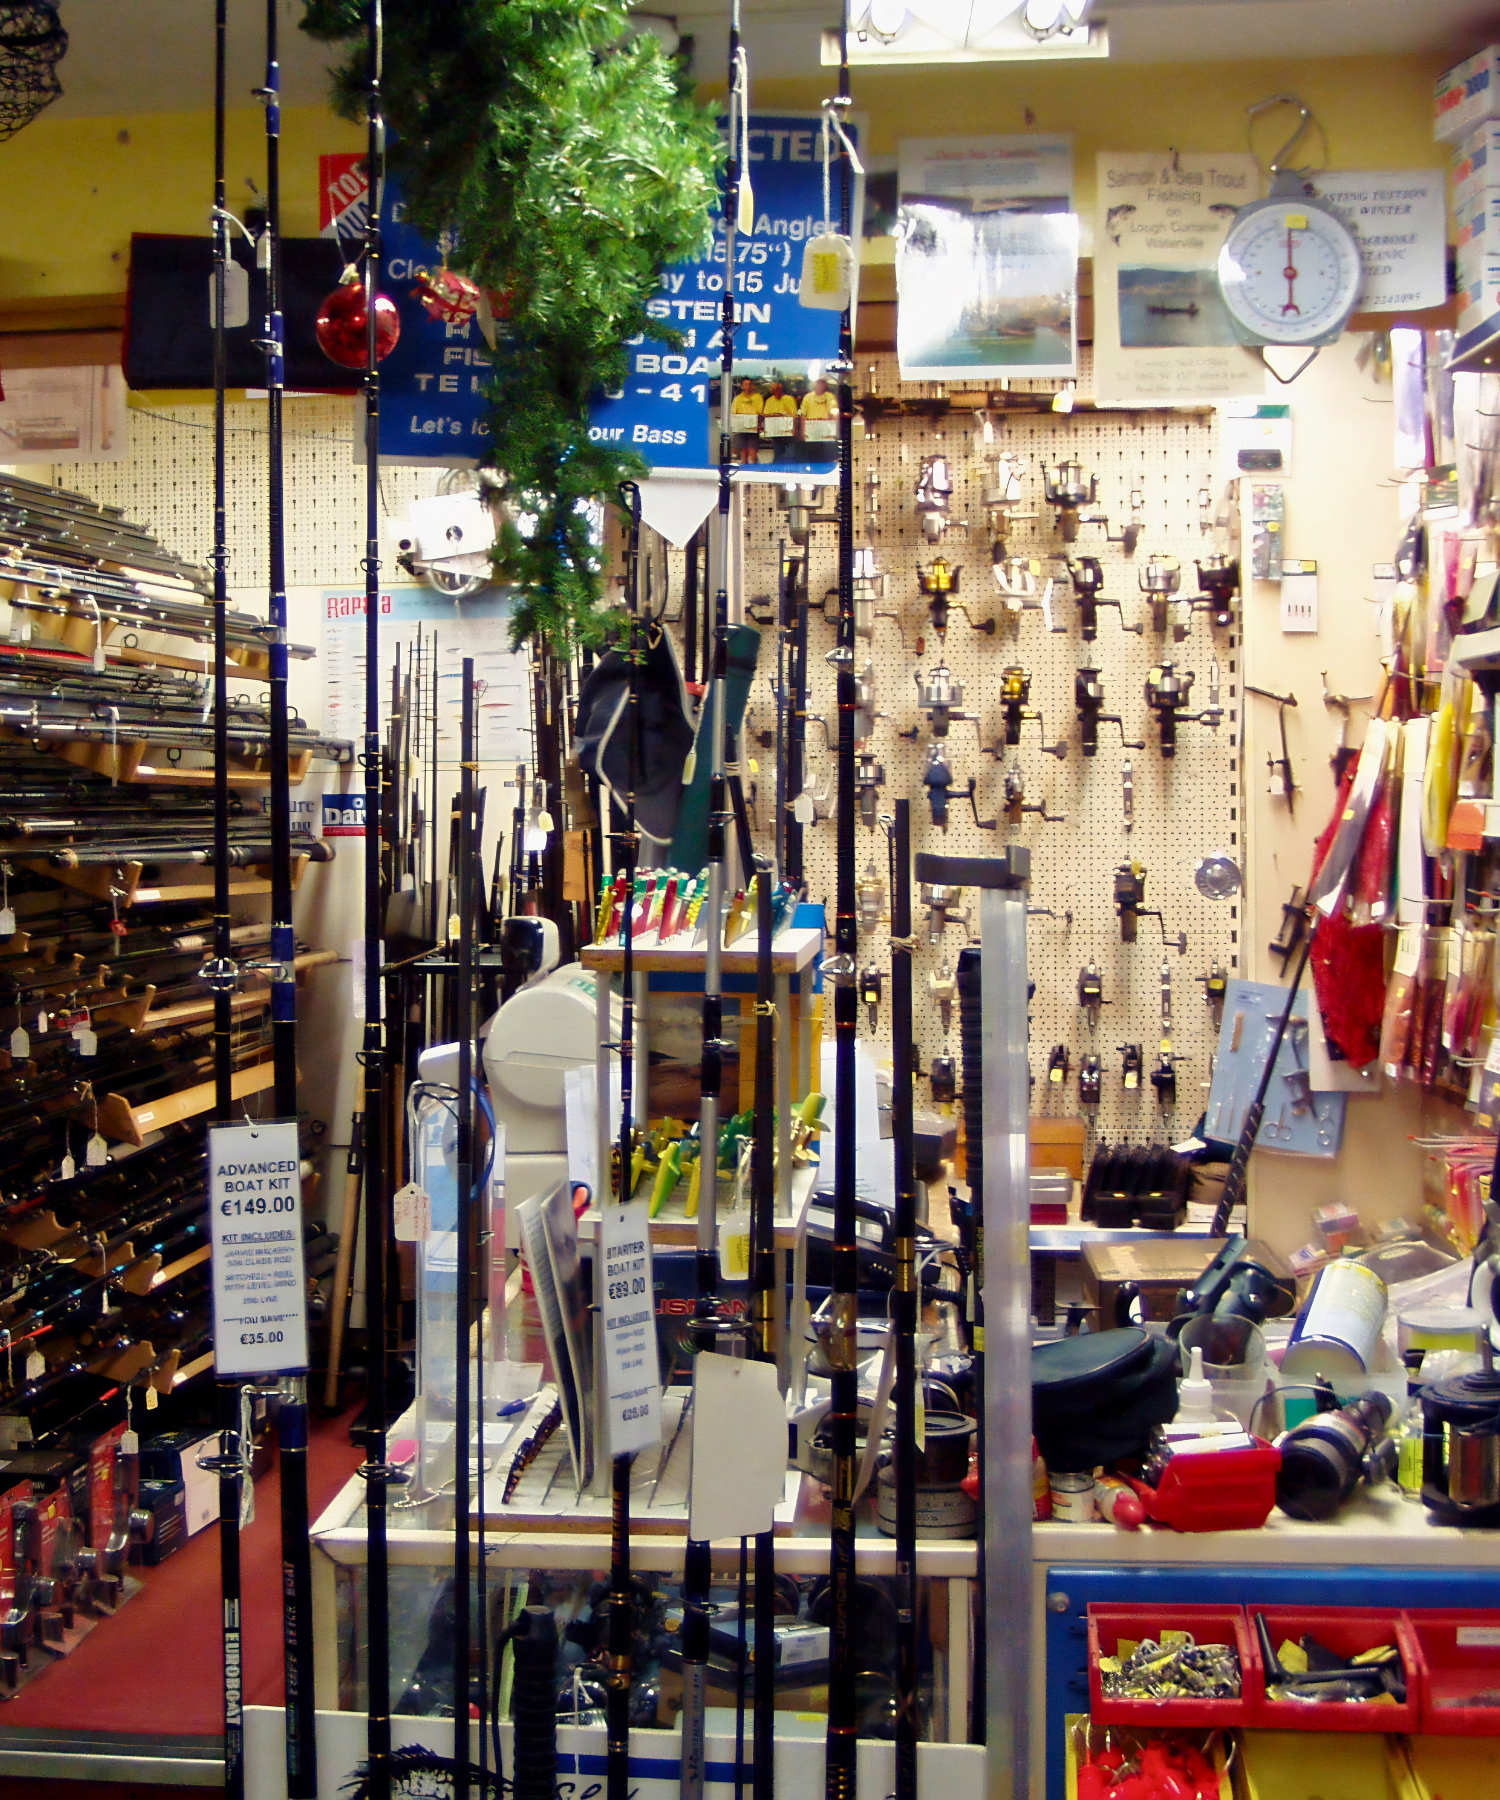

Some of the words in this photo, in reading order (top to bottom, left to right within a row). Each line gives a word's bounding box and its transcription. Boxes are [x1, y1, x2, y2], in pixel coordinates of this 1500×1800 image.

[722, 128, 841, 163] CTED
[388, 258, 428, 280] Clo
[696, 270, 723, 291] to
[734, 271, 763, 294] 15
[773, 272, 802, 294] Ju
[646, 298, 771, 323] STERN
[636, 354, 711, 376] BOA
[410, 415, 463, 436] Let's
[632, 424, 688, 445] Bass
[217, 1160, 297, 1177] ADVANCED
[224, 1179, 264, 1193] BOAT
[268, 1177, 291, 1190] KIT
[221, 1195, 296, 1217] €149.00
[222, 1233, 238, 1245] KIT
[607, 1240, 646, 1260] STARTER
[607, 1261, 630, 1277] BOAT
[240, 1330, 284, 1345] €35.00
[224, 1631, 242, 1727] EUROBOAT
